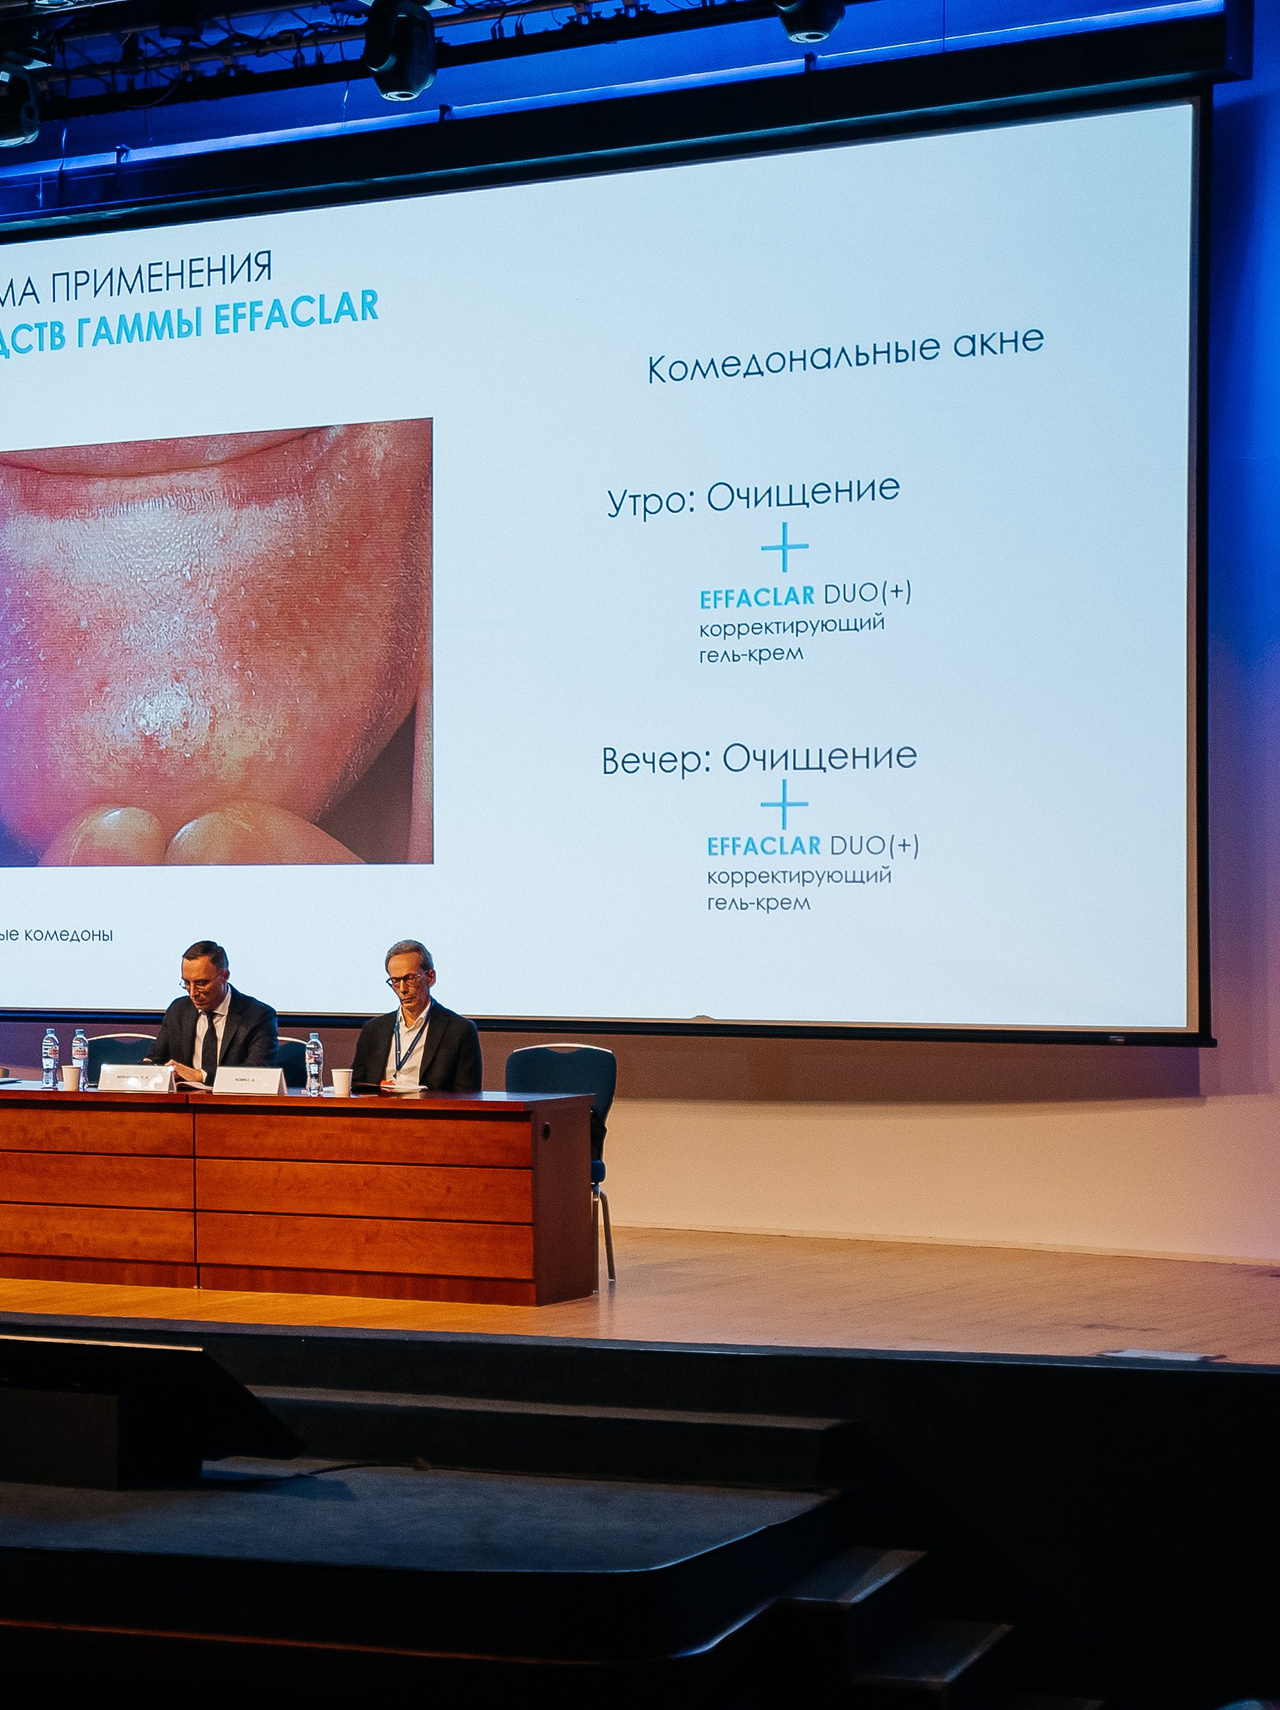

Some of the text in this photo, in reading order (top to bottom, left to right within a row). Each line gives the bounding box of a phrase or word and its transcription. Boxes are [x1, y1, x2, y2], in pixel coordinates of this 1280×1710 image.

[52, 249, 272, 303] ПРИМЕНЕНИЯ
[78, 306, 202, 348] ГАММЫ
[215, 289, 379, 335] EFFACLAR
[649, 328, 1045, 384] Комедональные акне
[607, 477, 901, 523] Утро: Очищение
[700, 579, 911, 610] EFFACLAR DUO(+)
[699, 611, 885, 640] корректирующий
[699, 647, 804, 665] гель-крем
[603, 742, 918, 780] Вечер: Очищение
[707, 834, 919, 860] EFFACLAR DUO(+)
[707, 865, 892, 888] корректирующий
[707, 896, 811, 914] гель-крем
[24, 929, 113, 943] комедоны
